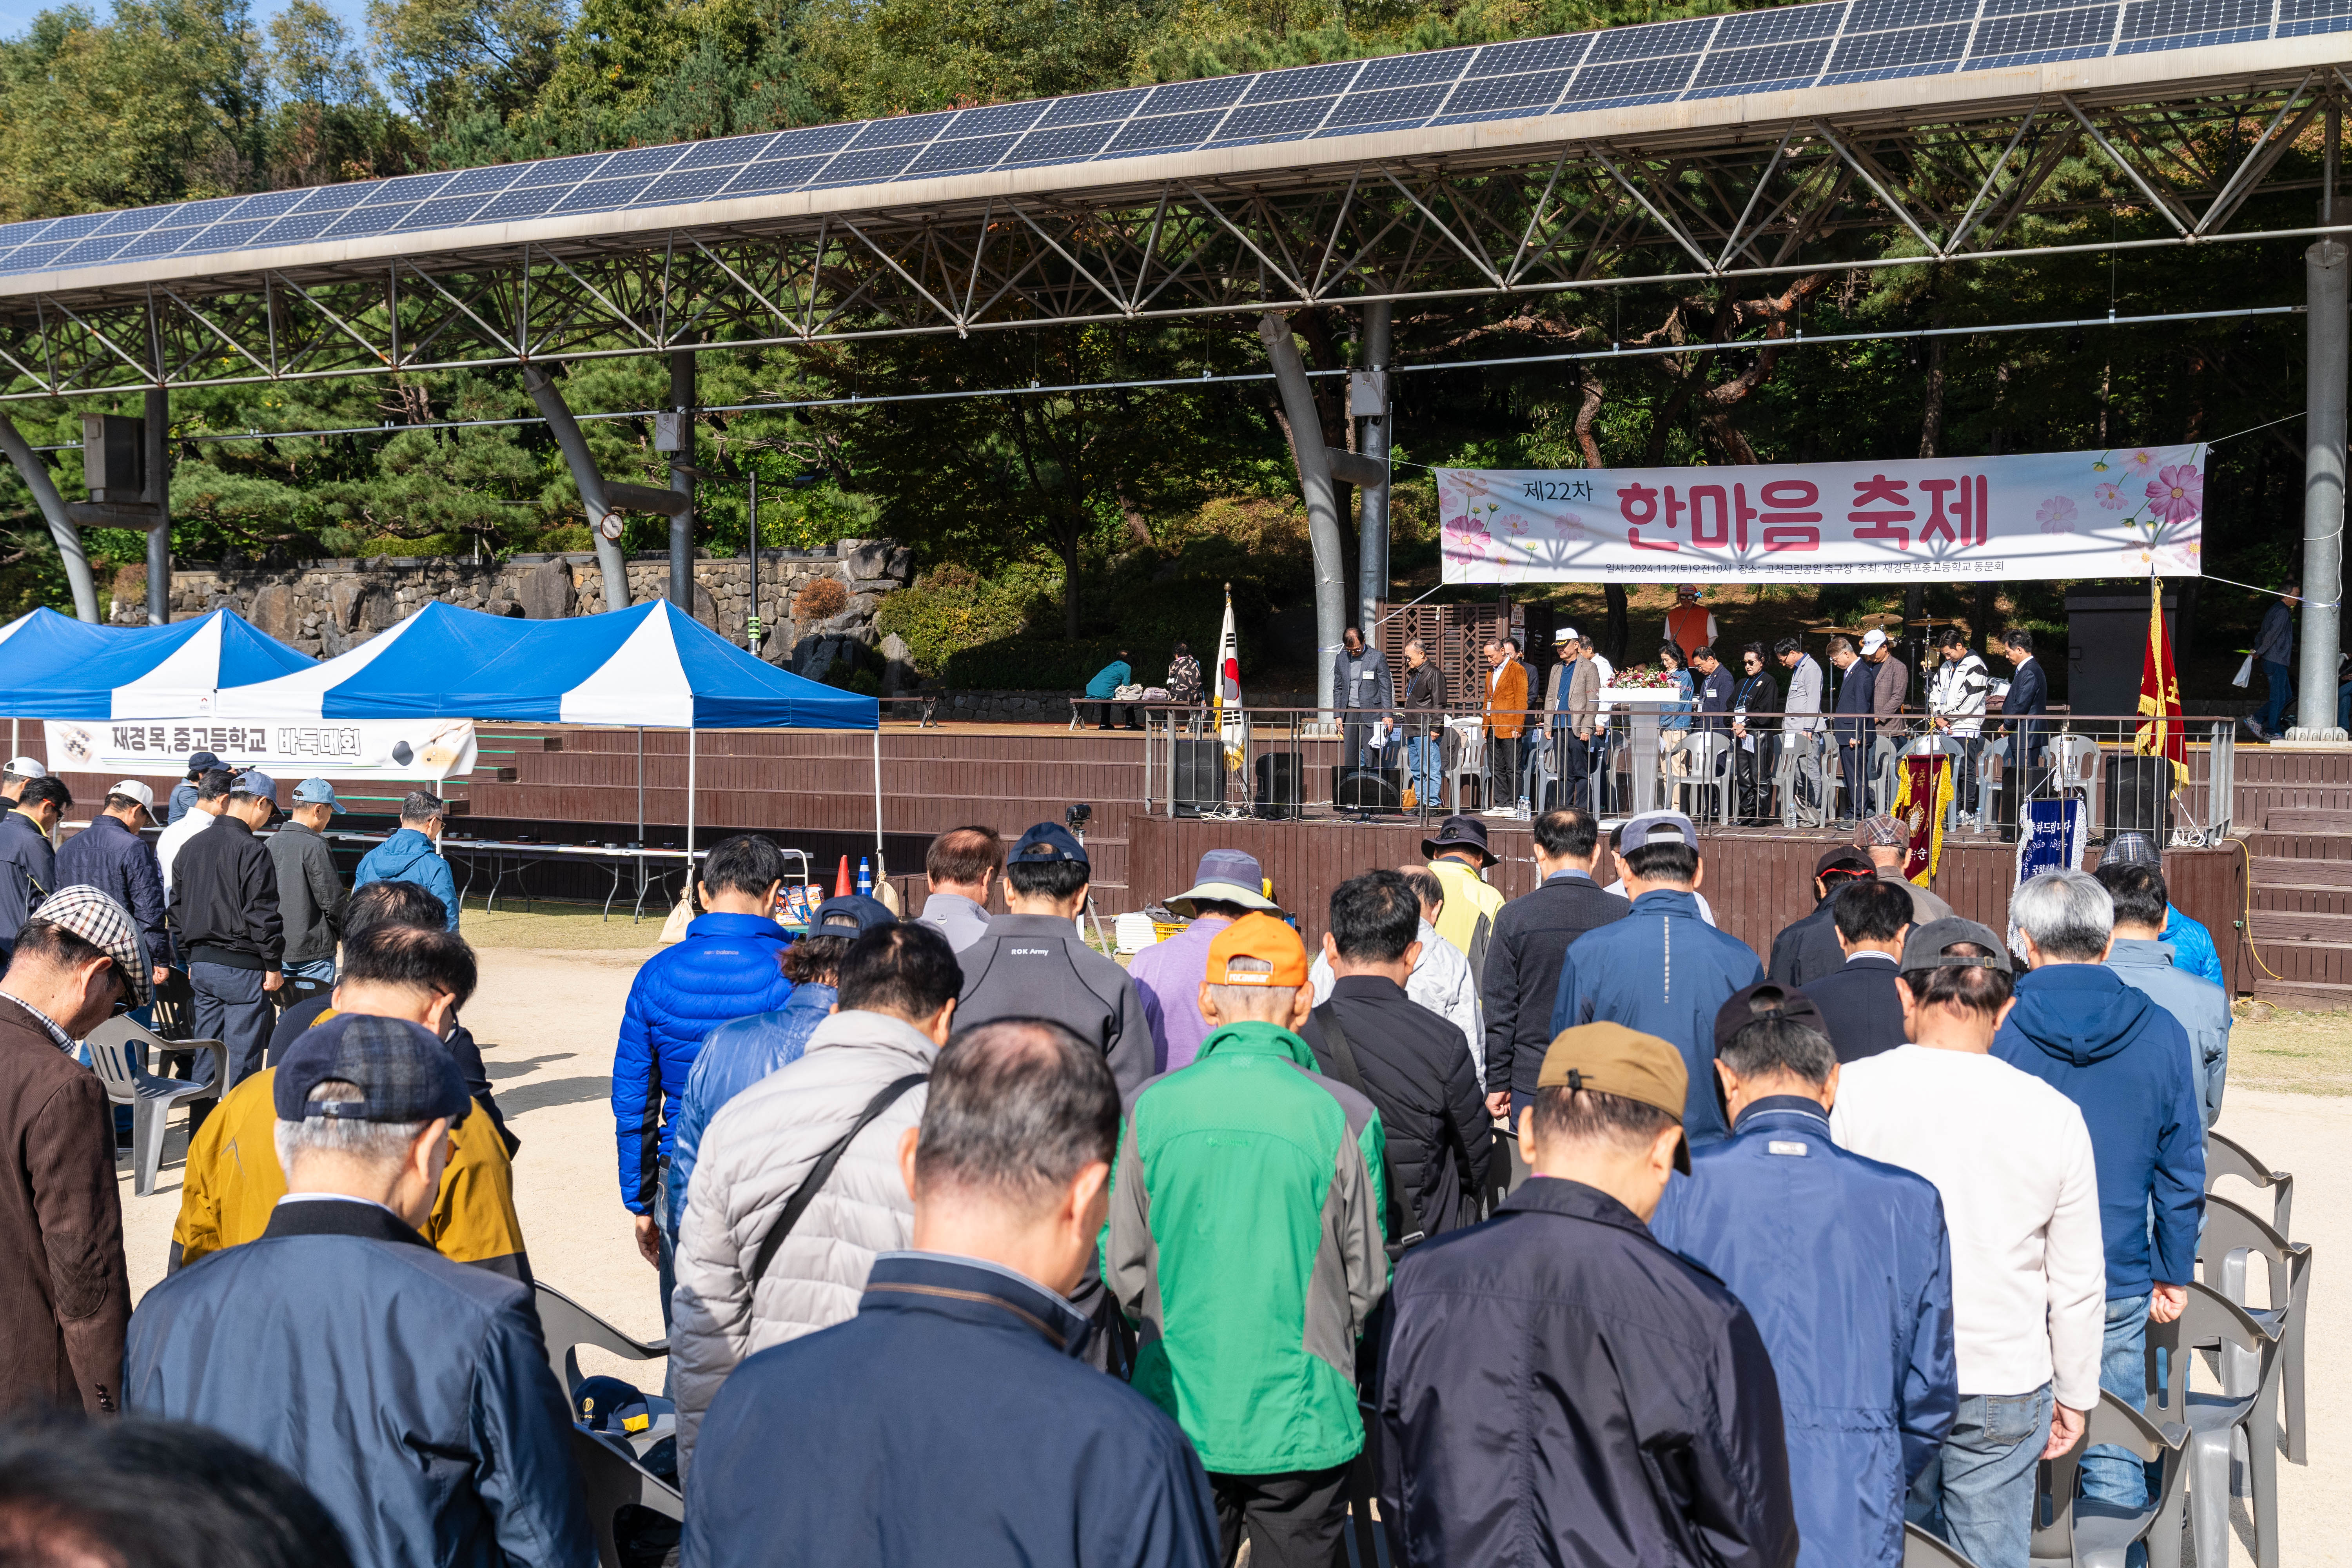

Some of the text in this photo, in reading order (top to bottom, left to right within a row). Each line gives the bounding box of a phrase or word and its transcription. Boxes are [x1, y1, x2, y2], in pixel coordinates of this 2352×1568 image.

[1524, 480, 1594, 502] 제22차
[1617, 474, 1988, 552] 한마음 축제
[1606, 561, 2004, 574] 일시: 2024.11.2(토)오전10시 장소: 고척근린공원 축구장 주최: 재경목포중고등학교 동문회
[112, 726, 361, 755] 재경 목,중고등학교 바둑대회
[1917, 769, 1926, 790] 축
[1229, 973, 1269, 983] rocawear
